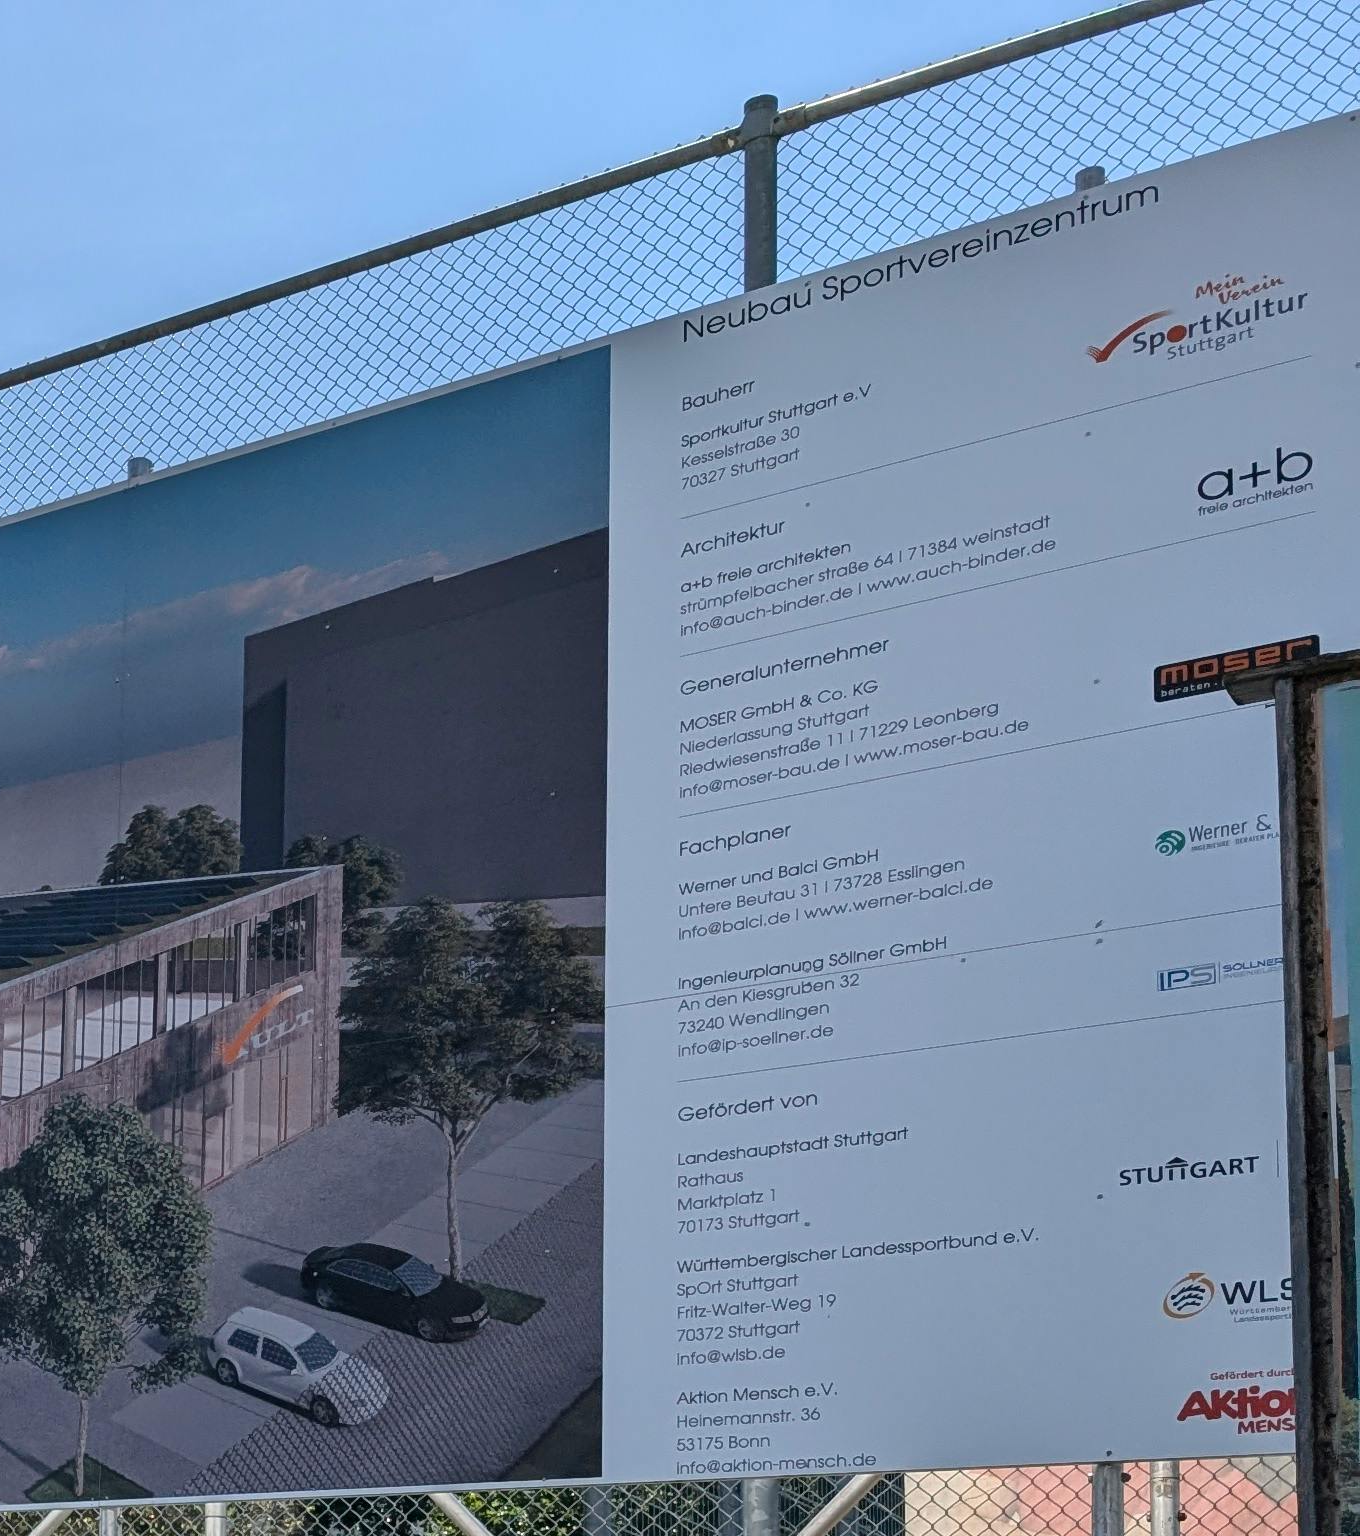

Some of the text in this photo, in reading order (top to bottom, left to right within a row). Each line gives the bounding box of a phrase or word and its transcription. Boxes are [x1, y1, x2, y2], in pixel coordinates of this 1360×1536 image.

[682, 185, 1159, 343] Neubau Sportvereinzentrum
[1195, 273, 1245, 299] Mein
[1218, 275, 1284, 305] Verein
[1133, 292, 1308, 355] SportKultur
[1167, 326, 1254, 360] Stuttgart
[682, 380, 755, 411] Bauherr
[681, 416, 764, 448] Sportkultur
[768, 394, 838, 424] Stuttgart
[682, 426, 800, 469] Kesselstraße 30
[682, 448, 800, 490] 70327 Stuttgart
[1197, 447, 1313, 501] a+b
[1232, 482, 1314, 508] architekten
[681, 521, 786, 558] Architektur
[680, 515, 1051, 616] strümpfelbacher straße 64 71384 weinstadt
[680, 541, 851, 594] a+b freie architekten
[680, 537, 1057, 638] info@auch-binder.de www.auch-binder.de
[680, 638, 889, 696] Generalunternehmer
[1161, 639, 1312, 686] moser
[680, 679, 879, 733] MOSER GmbH & Co. KG
[1161, 682, 1210, 697] beraten
[680, 704, 870, 755] Niederlassung Stuttgart
[680, 701, 1000, 777] Riedwiesenstraße 11 71229 Leonberg
[679, 718, 1029, 799] info@moser-bau.de www.moser-bau.de
[679, 824, 792, 857] Fachplaner
[1189, 821, 1248, 843] Werner
[1256, 814, 1271, 832] &
[679, 849, 879, 896] Werner und Balci GmbH
[679, 858, 966, 918] Untere Beutau 31 73728 Esslingen
[679, 877, 994, 941] info@balci.de www.werner-balci.de
[678, 936, 948, 991] Ingenieurplanung Söllner GmbH
[1160, 966, 1213, 991] IPS
[678, 974, 860, 1013] An den Kiesgruben 32
[678, 1002, 830, 1035] 73240 Wendlingen
[678, 1025, 834, 1058] info@ip-soellner.de
[678, 1092, 818, 1123] Gefördert von
[678, 1126, 909, 1166] Landeshauptstadt Stuttgart
[678, 1169, 744, 1189] Rathaus
[1119, 1156, 1260, 1187] STUTTGART
[678, 1191, 764, 1212] Marktplatz
[678, 1209, 801, 1234] 70173 Stuttgart
[677, 1227, 1040, 1275] Württembergischer Landessportbund e.V.
[676, 1273, 800, 1298] SpOrt Stuttgart
[677, 1293, 837, 1320] Fritz-Walter-Weg 19
[677, 1320, 800, 1342] 70372 Stuttgart
[677, 1346, 786, 1365] info@wlsb.de
[1210, 1369, 1264, 1381] Gefördert
[676, 1382, 838, 1405] Aktion Mensch e.V.
[677, 1407, 821, 1428] Heinemannstr. 36
[1238, 1418, 1296, 1434] MENS
[676, 1433, 771, 1452] 53175 Bonn
[677, 1452, 877, 1475] info@aktion-mensch.de
